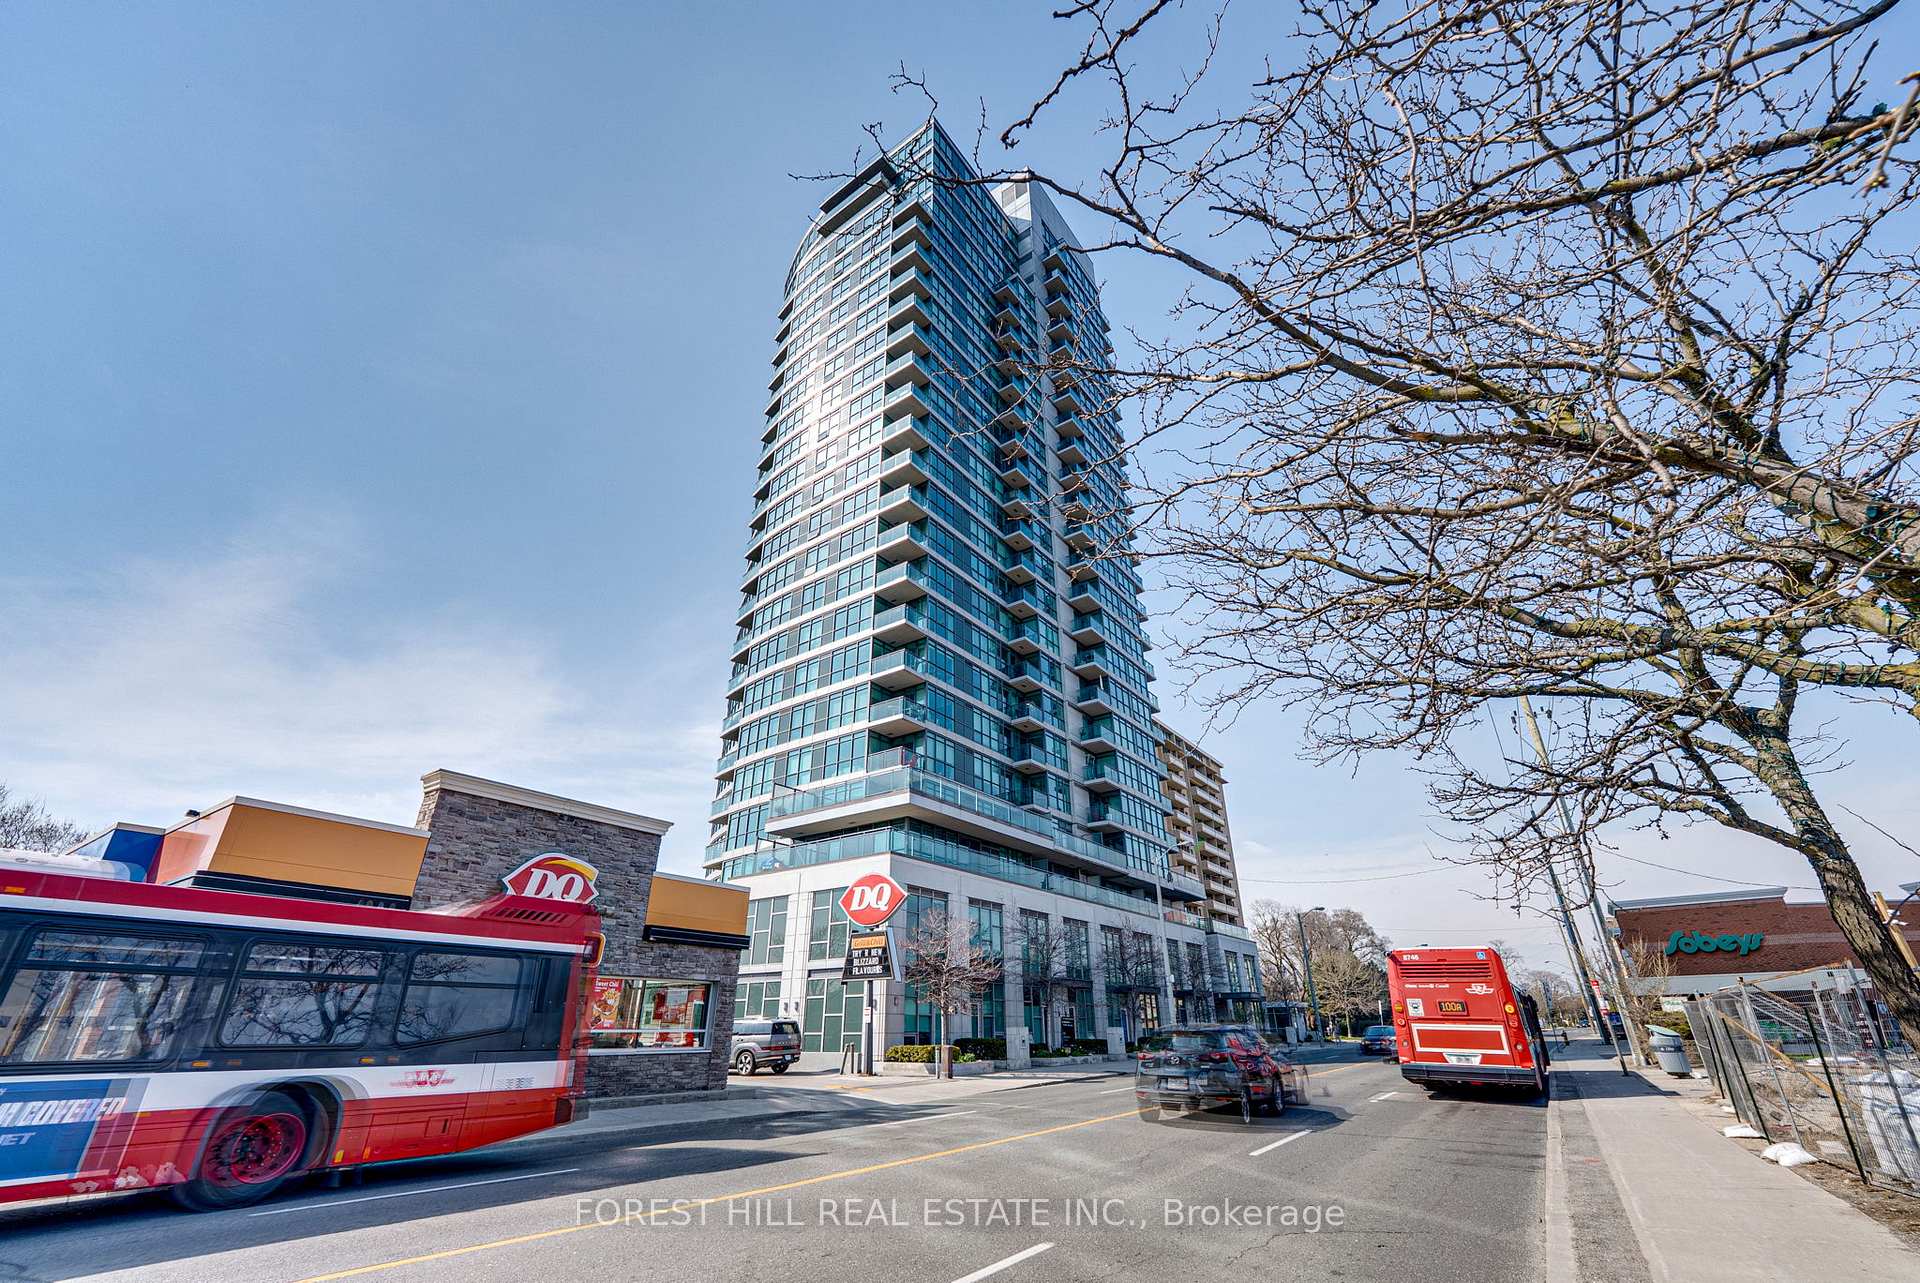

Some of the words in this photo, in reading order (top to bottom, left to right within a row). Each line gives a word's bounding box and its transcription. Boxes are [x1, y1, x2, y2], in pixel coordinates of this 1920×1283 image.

[521, 868, 584, 902] DQ
[850, 883, 892, 911] DQ
[852, 950, 862, 958] TRY
[871, 948, 883, 956] NEW
[853, 957, 879, 966] BLIZZARD
[852, 965, 883, 975] FLAVOURS
